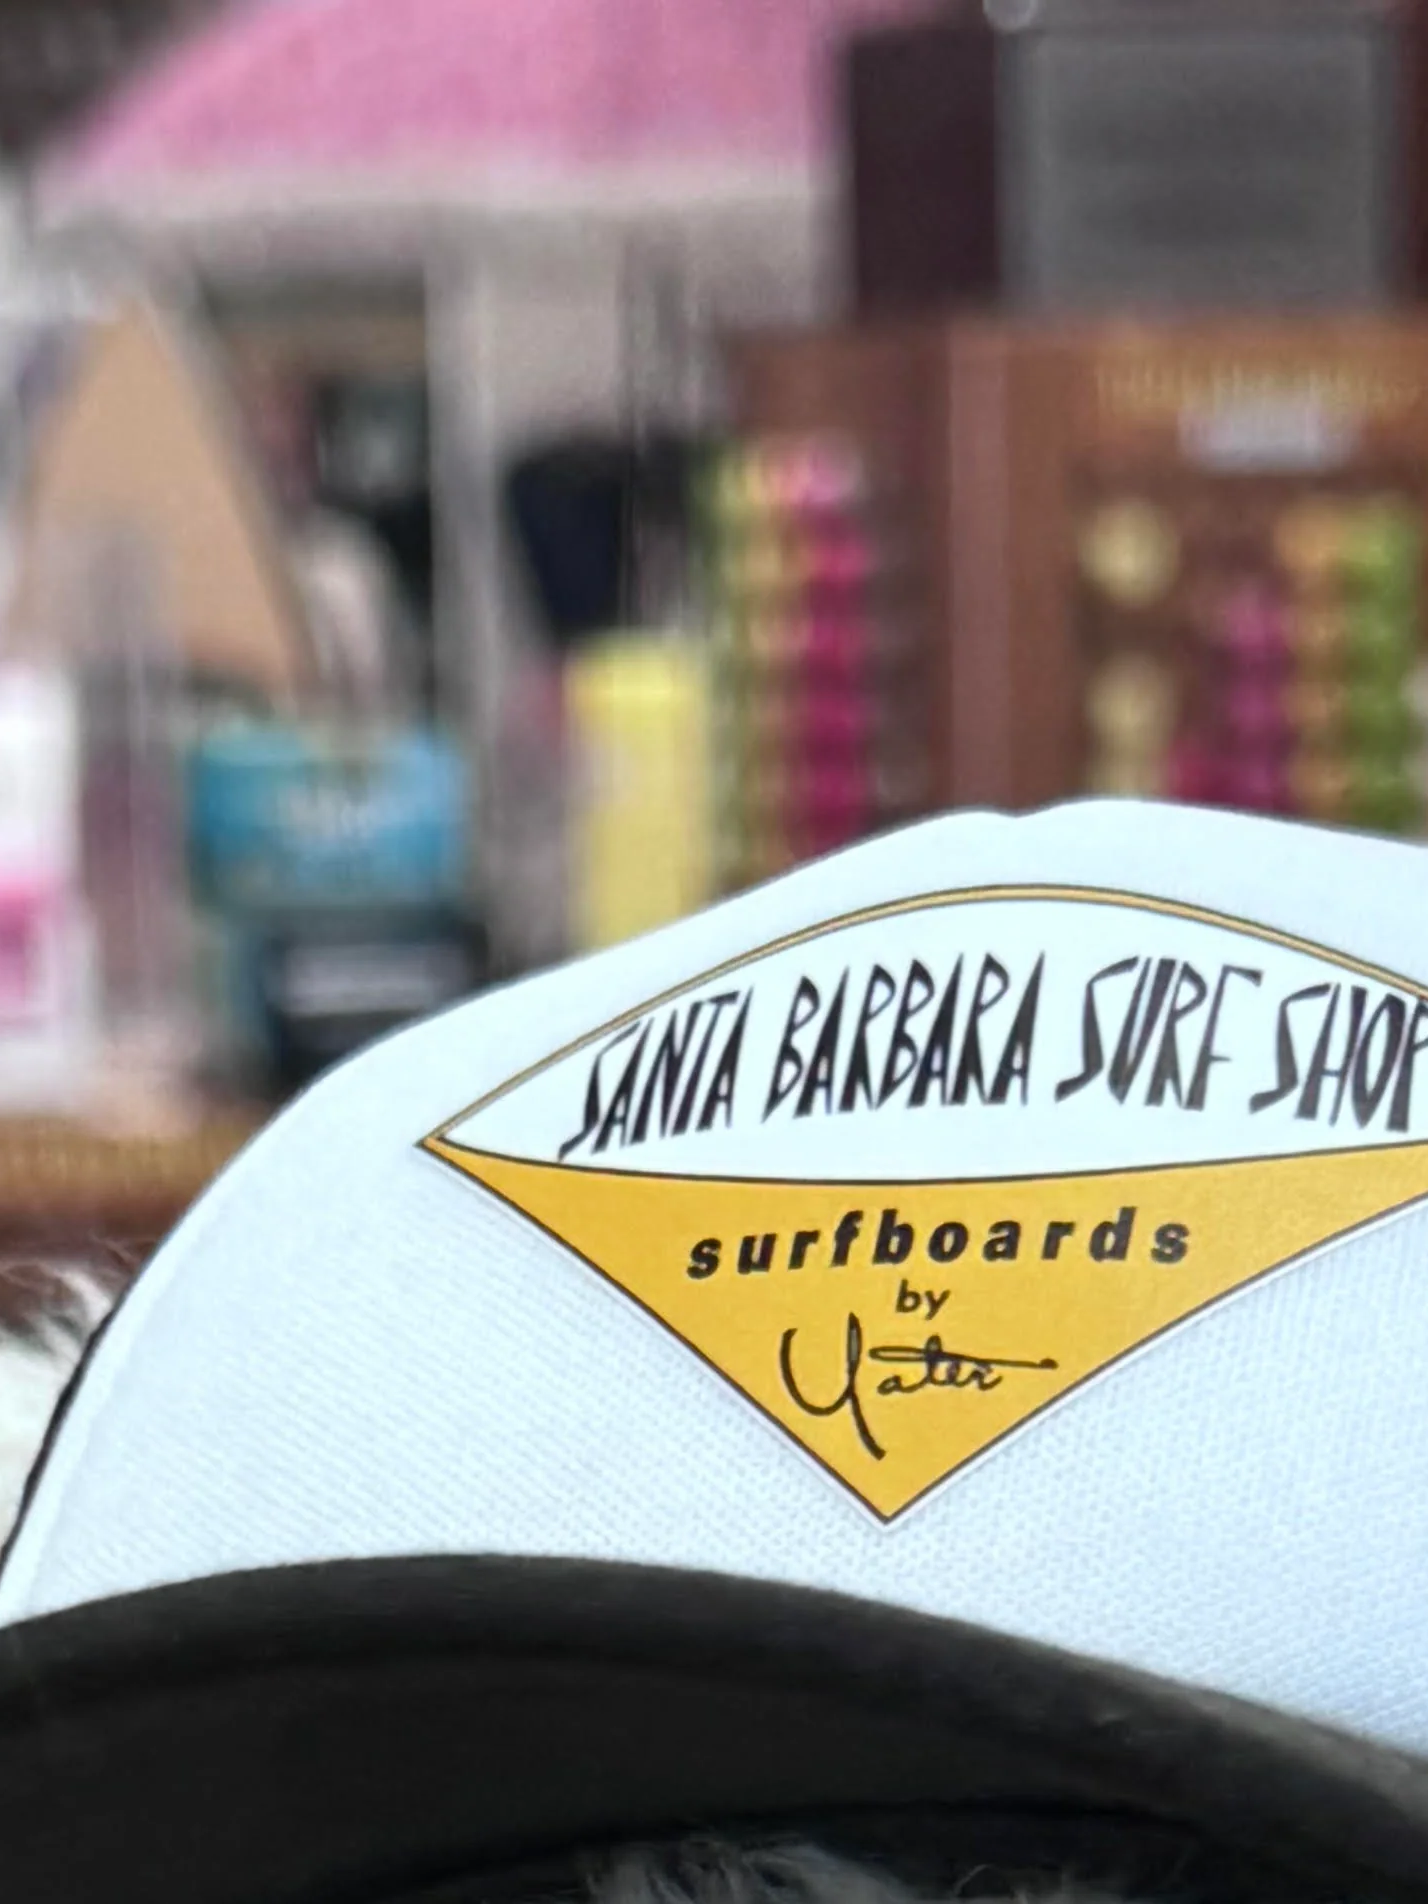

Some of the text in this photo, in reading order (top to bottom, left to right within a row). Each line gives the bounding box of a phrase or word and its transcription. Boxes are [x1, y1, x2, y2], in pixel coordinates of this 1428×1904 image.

[558, 988, 753, 1160] SANTA
[762, 952, 1045, 1122] BARBARA
[1055, 956, 1263, 1111] SURF
[687, 1207, 1190, 1279] surfboards
[895, 1279, 951, 1318] by
[780, 1312, 1058, 1461] Yater
